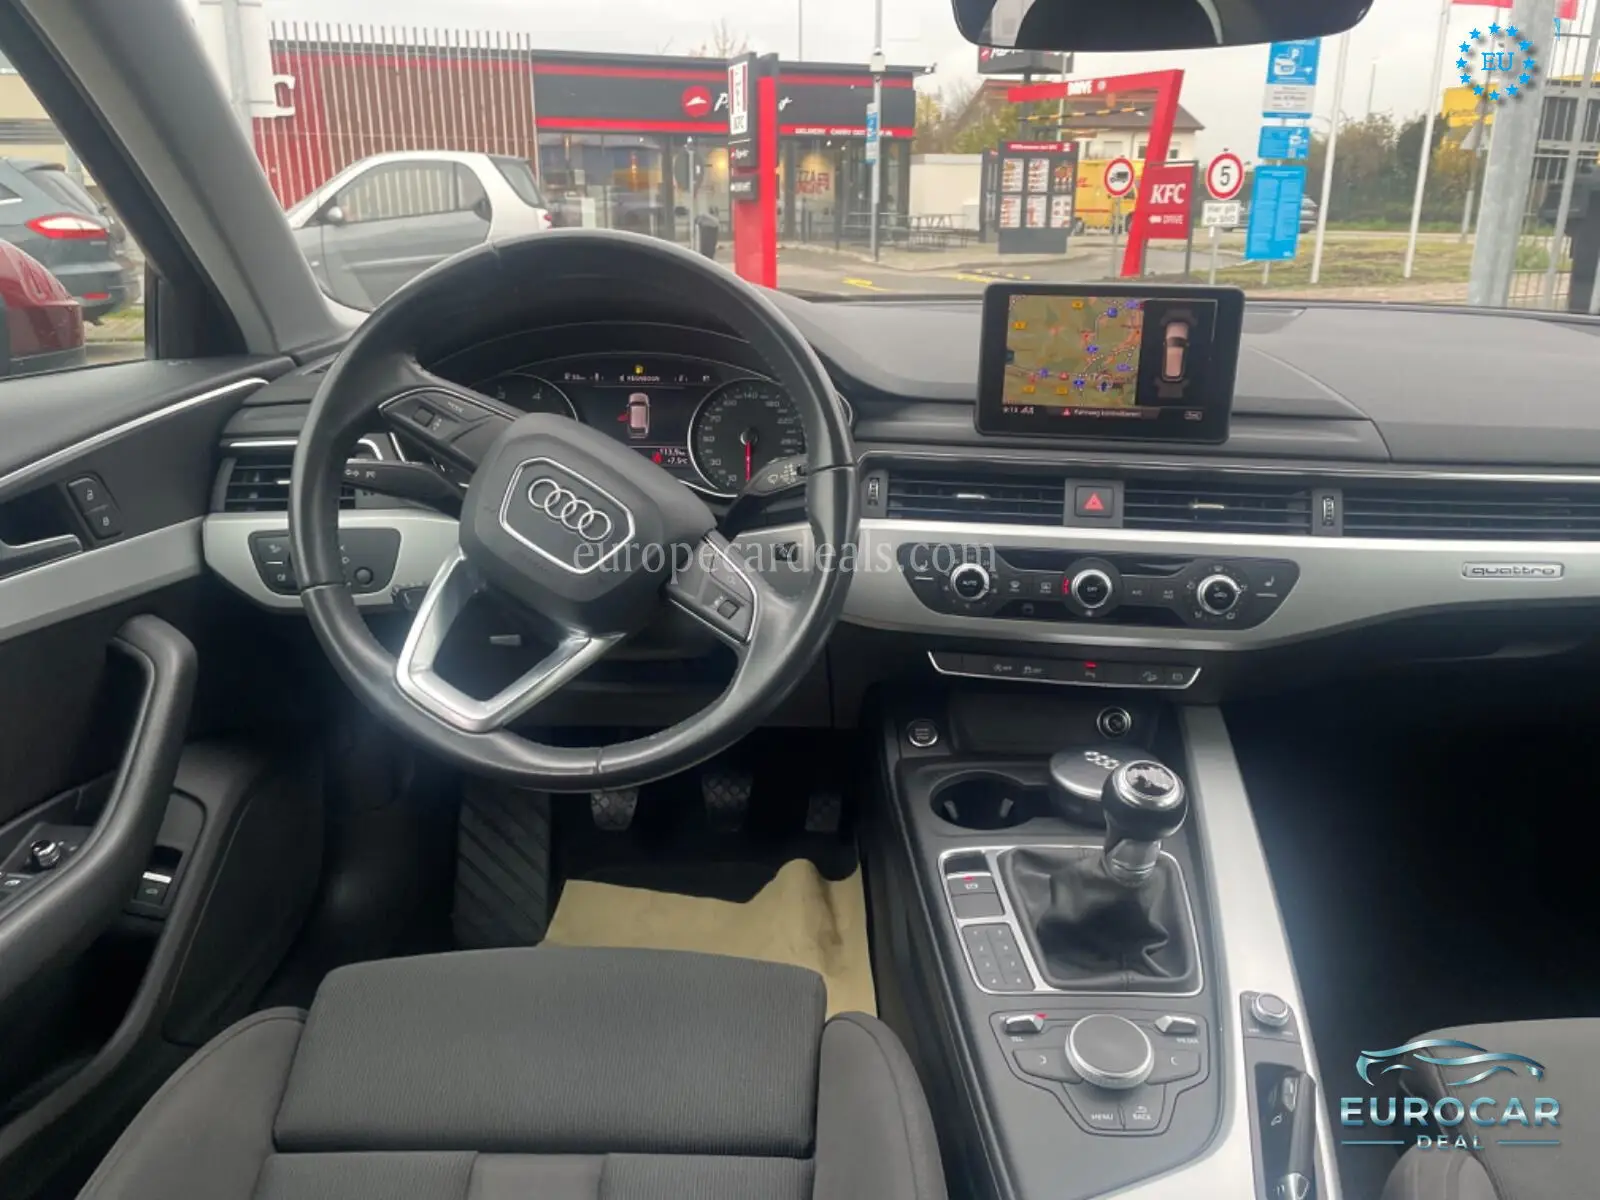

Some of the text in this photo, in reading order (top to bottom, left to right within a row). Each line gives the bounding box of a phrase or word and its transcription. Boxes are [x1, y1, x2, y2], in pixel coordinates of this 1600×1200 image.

[1220, 166, 1231, 186] 5
[1150, 183, 1187, 205] KFC
[1472, 566, 1555, 575] quattro
